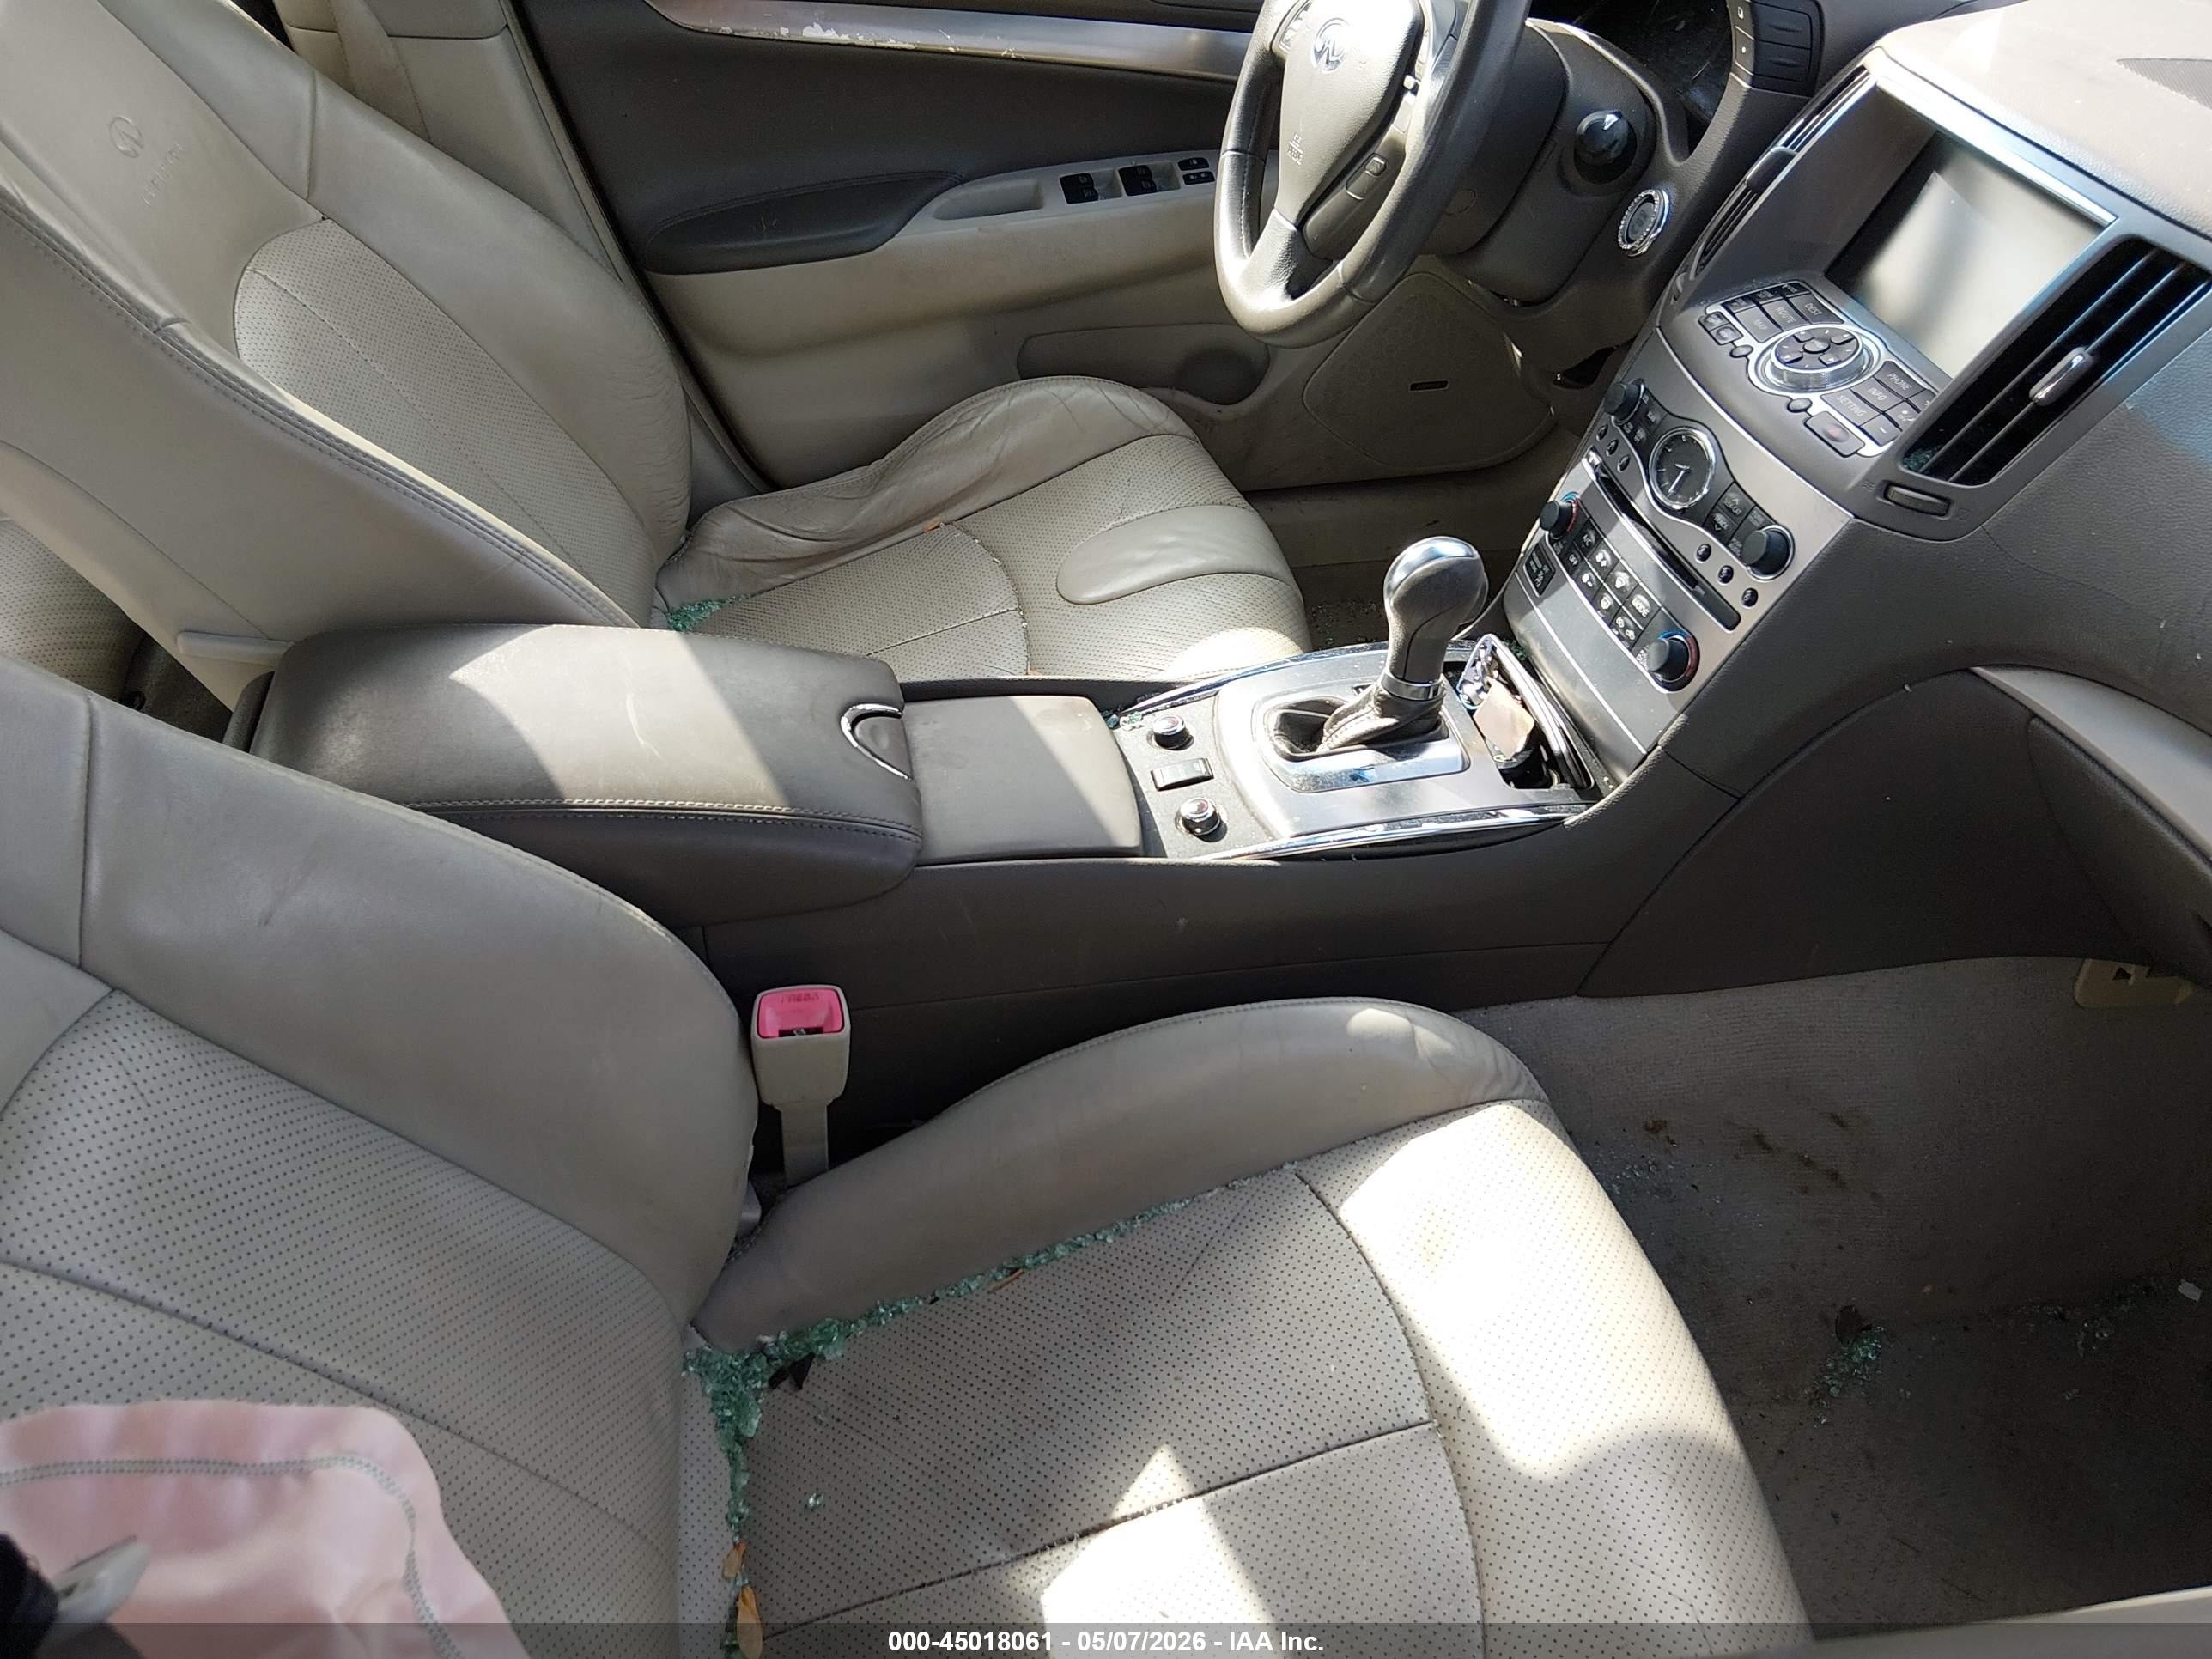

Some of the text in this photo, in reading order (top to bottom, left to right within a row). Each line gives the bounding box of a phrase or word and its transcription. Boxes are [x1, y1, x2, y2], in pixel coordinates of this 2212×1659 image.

[1776, 307, 1796, 324] ROUTE
[1805, 302, 1822, 316] DEST
[1887, 373, 1912, 391] PHONE
[1868, 387, 1887, 401] INFO
[1837, 395, 1867, 417] SETTING
[1713, 514, 1729, 530] TRACK
[1568, 554, 1578, 566] OFF
[1632, 597, 1650, 617] MODE
